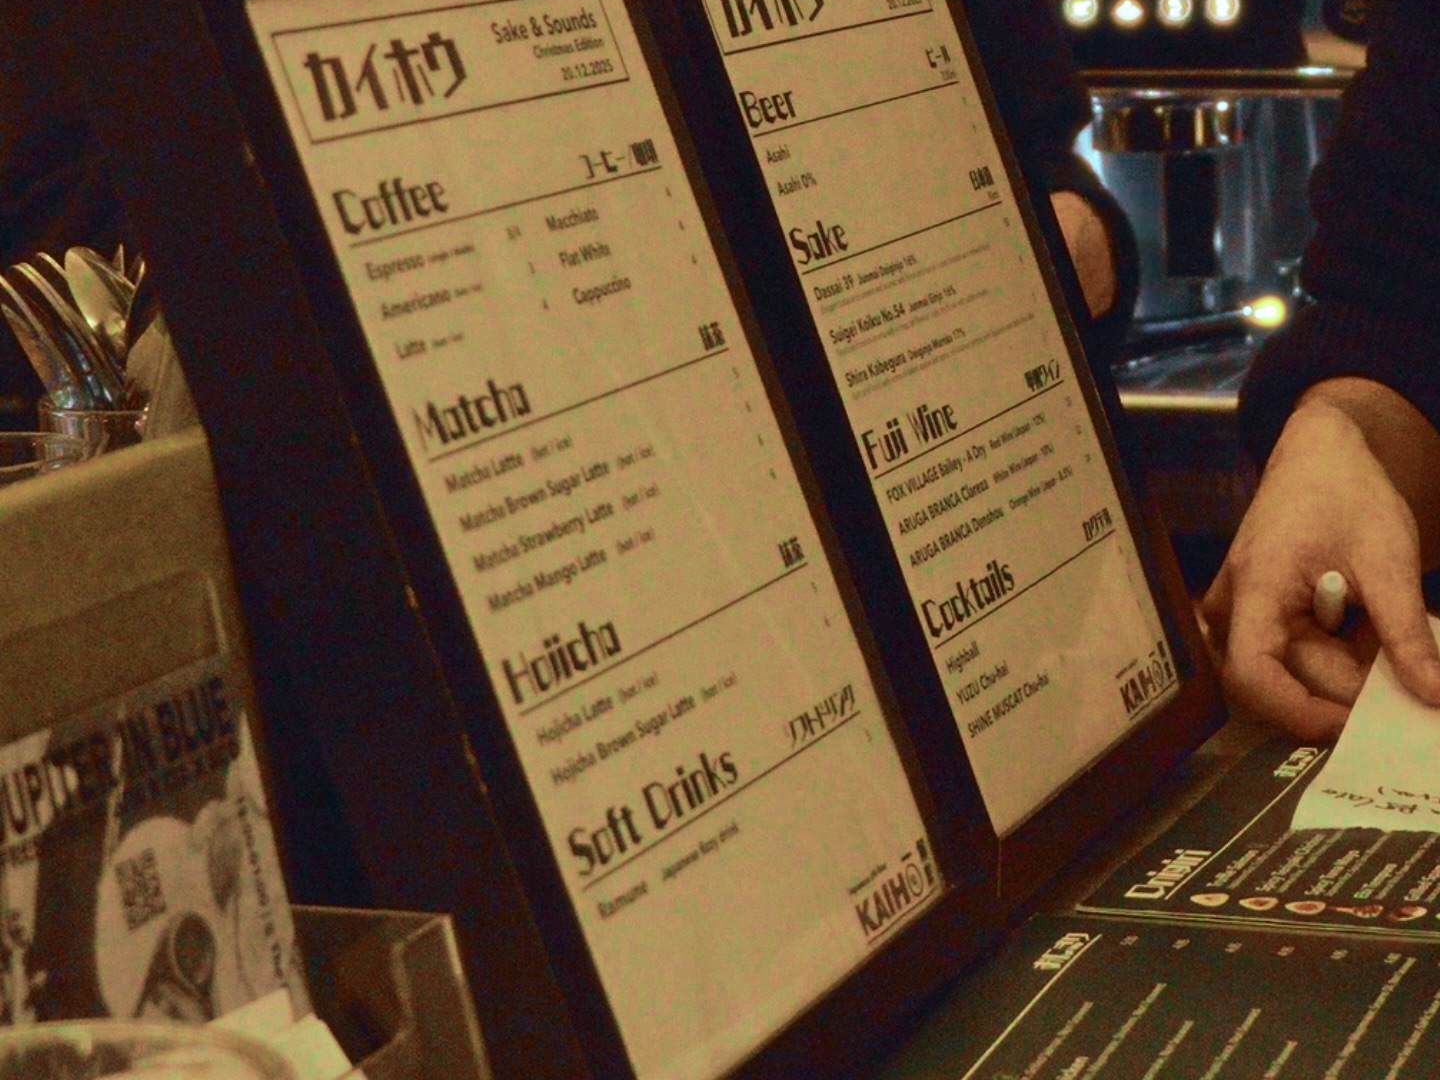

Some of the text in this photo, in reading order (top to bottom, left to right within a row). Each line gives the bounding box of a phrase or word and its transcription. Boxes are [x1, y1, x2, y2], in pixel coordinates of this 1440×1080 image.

[490, 9, 597, 44] Sake & Sounds
[533, 38, 604, 59] Christmas Edition
[561, 58, 614, 81] 20.12.2025
[306, 34, 465, 120] カイホウ
[739, 90, 796, 129] Beer
[766, 148, 790, 164] Asahi
[777, 172, 817, 195] Asahi 0%
[333, 178, 447, 235] Coffee
[545, 208, 599, 231] Macchiato
[558, 244, 611, 267] Flat White
[789, 221, 848, 265] Sake
[365, 255, 425, 281] Espresso
[813, 283, 843, 302] Dassai
[842, 274, 854, 291] 39
[381, 290, 451, 319] Americano
[572, 277, 631, 305] Cappuccino
[829, 325, 858, 345] Suigei
[880, 303, 906, 322] No.54
[397, 340, 426, 360] Latte
[844, 370, 869, 388] Shira
[867, 353, 907, 377] Kabegura
[416, 381, 531, 443] Matcha
[861, 404, 957, 470] Fuji Wine
[445, 467, 491, 492] Matcha
[493, 454, 524, 477] Latte
[885, 484, 907, 502] FOX
[905, 466, 940, 493] VILLAGE
[937, 457, 963, 478] Bailey
[966, 449, 976, 463] A
[971, 444, 987, 460] Dry
[459, 506, 506, 531] Matcha
[504, 488, 547, 515] Brown
[545, 473, 582, 497] Sugar
[582, 462, 610, 483] Latte
[898, 510, 930, 535] ARUGA
[927, 493, 962, 519] BRANCA
[473, 545, 520, 572] Matcha
[518, 516, 585, 553] Strawberry
[586, 503, 614, 525] Latte
[909, 542, 941, 567] ARUGA
[938, 523, 973, 551] BRANCA
[488, 583, 534, 612] Matcha
[533, 563, 579, 591] Mango
[579, 549, 607, 572] Latte
[922, 561, 1014, 637] Cocktails
[503, 622, 620, 703] Hojicha
[946, 641, 980, 673] Highball
[956, 664, 1009, 704] YUZU Chu-hai
[536, 713, 583, 744] Hojicha
[583, 697, 613, 722] Latte
[968, 710, 993, 738] SHINE
[992, 687, 1023, 719] MUSCAT
[551, 753, 597, 784] Hojicha
[596, 730, 637, 760] Brown
[635, 711, 669, 739] Sugar
[670, 696, 696, 720] Latte
[568, 753, 738, 875] Soft Drinks
[1126, 849, 1209, 899] Onigiri
[597, 882, 648, 919] Ramune
